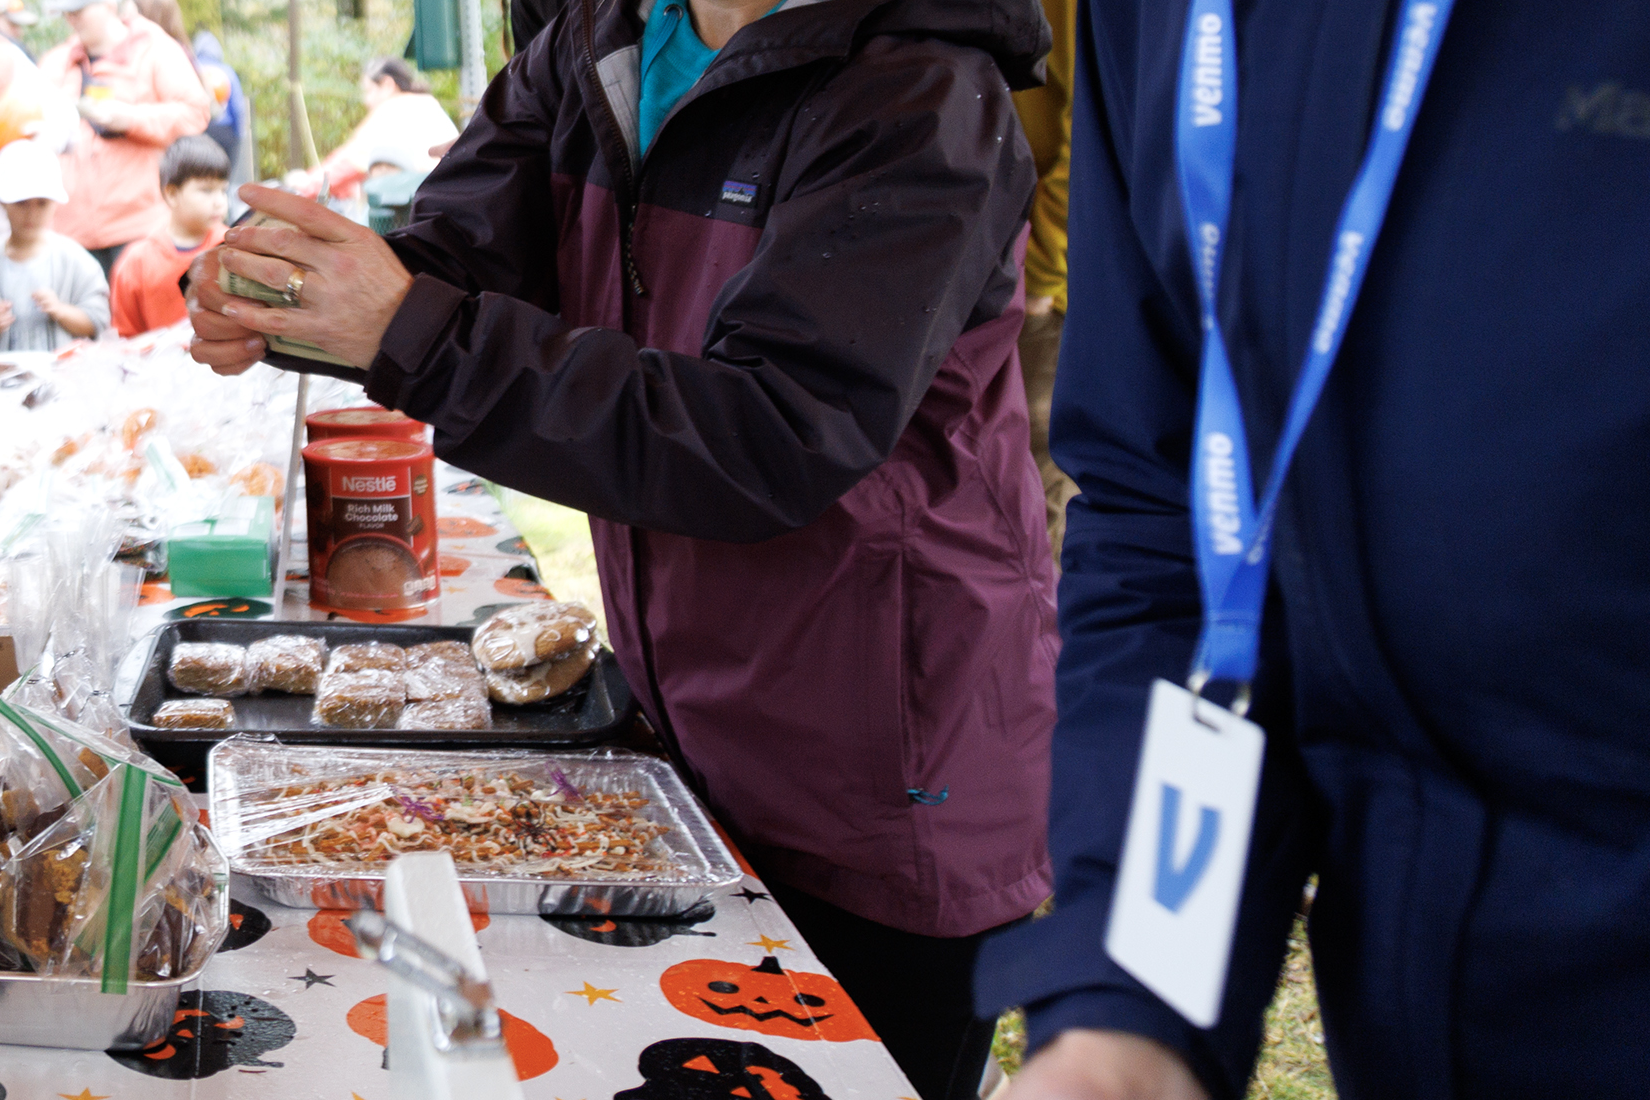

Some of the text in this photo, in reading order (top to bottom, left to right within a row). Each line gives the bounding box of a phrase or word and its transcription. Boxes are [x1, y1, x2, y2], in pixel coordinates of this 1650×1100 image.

[1192, 13, 1223, 127] venmo
[372, 504, 395, 513] Milk
[1206, 432, 1243, 555] venmo
